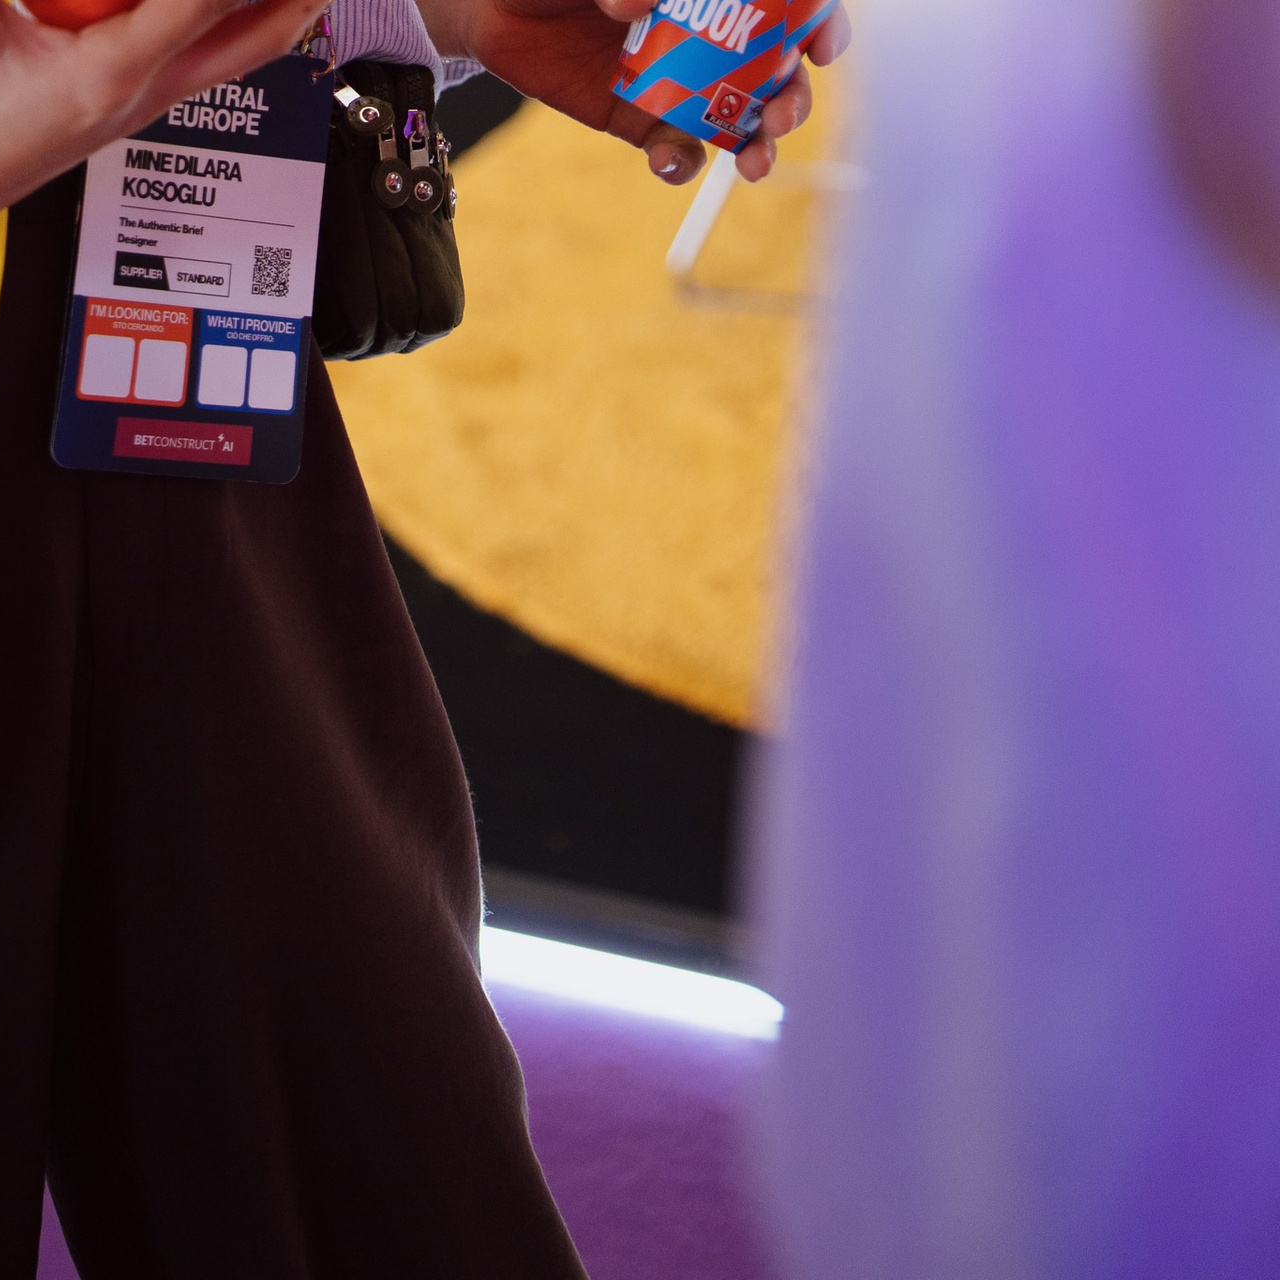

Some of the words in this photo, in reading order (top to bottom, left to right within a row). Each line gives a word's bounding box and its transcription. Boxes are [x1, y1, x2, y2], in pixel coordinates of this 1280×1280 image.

[183, 83, 269, 111] NTRAL
[168, 103, 261, 136] EUROPE
[125, 148, 174, 173] MINE
[174, 154, 242, 182] DILARA
[122, 176, 216, 207] KOSOGLU
[119, 217, 136, 228] The
[138, 219, 181, 233] Authentic
[182, 224, 204, 235] Brief
[118, 233, 159, 247] Designer
[120, 265, 163, 280] SUPPLIER
[177, 272, 224, 286] STANDARD
[90, 304, 107, 317] I'M
[108, 305, 161, 322] LOOKING
[162, 311, 189, 325] FOR:
[207, 315, 240, 329] WHAT
[240, 318, 245, 329] I
[245, 318, 296, 334] PROVIDE:
[133, 434, 216, 451] BETCONSTRUCT
[222, 441, 234, 452] AI
